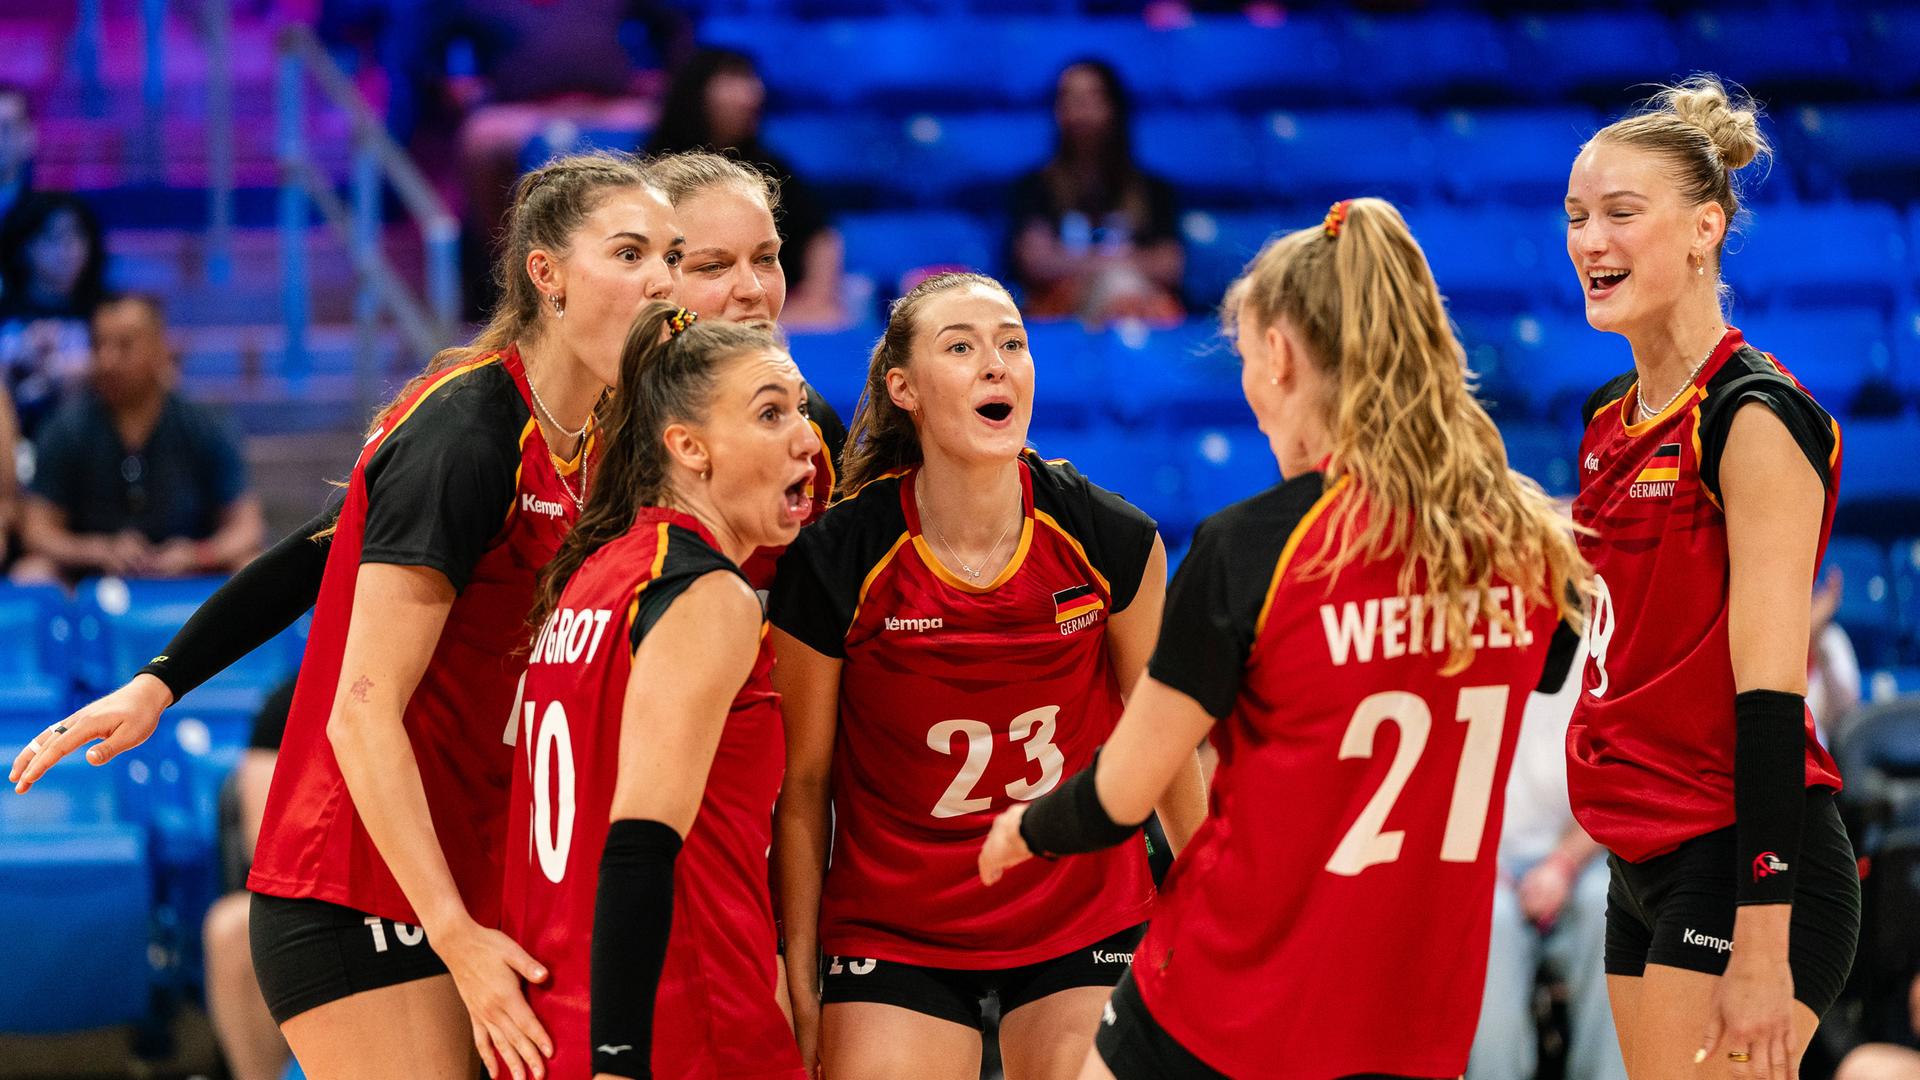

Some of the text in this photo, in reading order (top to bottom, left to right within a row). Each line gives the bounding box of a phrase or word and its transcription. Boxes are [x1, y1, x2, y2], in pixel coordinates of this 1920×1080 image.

[1629, 482, 1675, 498] GERMANY
[1060, 610, 1099, 636] GERMANY
[926, 705, 1065, 819] 23
[1324, 684, 1510, 877] 21
[1092, 949, 1136, 967] Kemp
